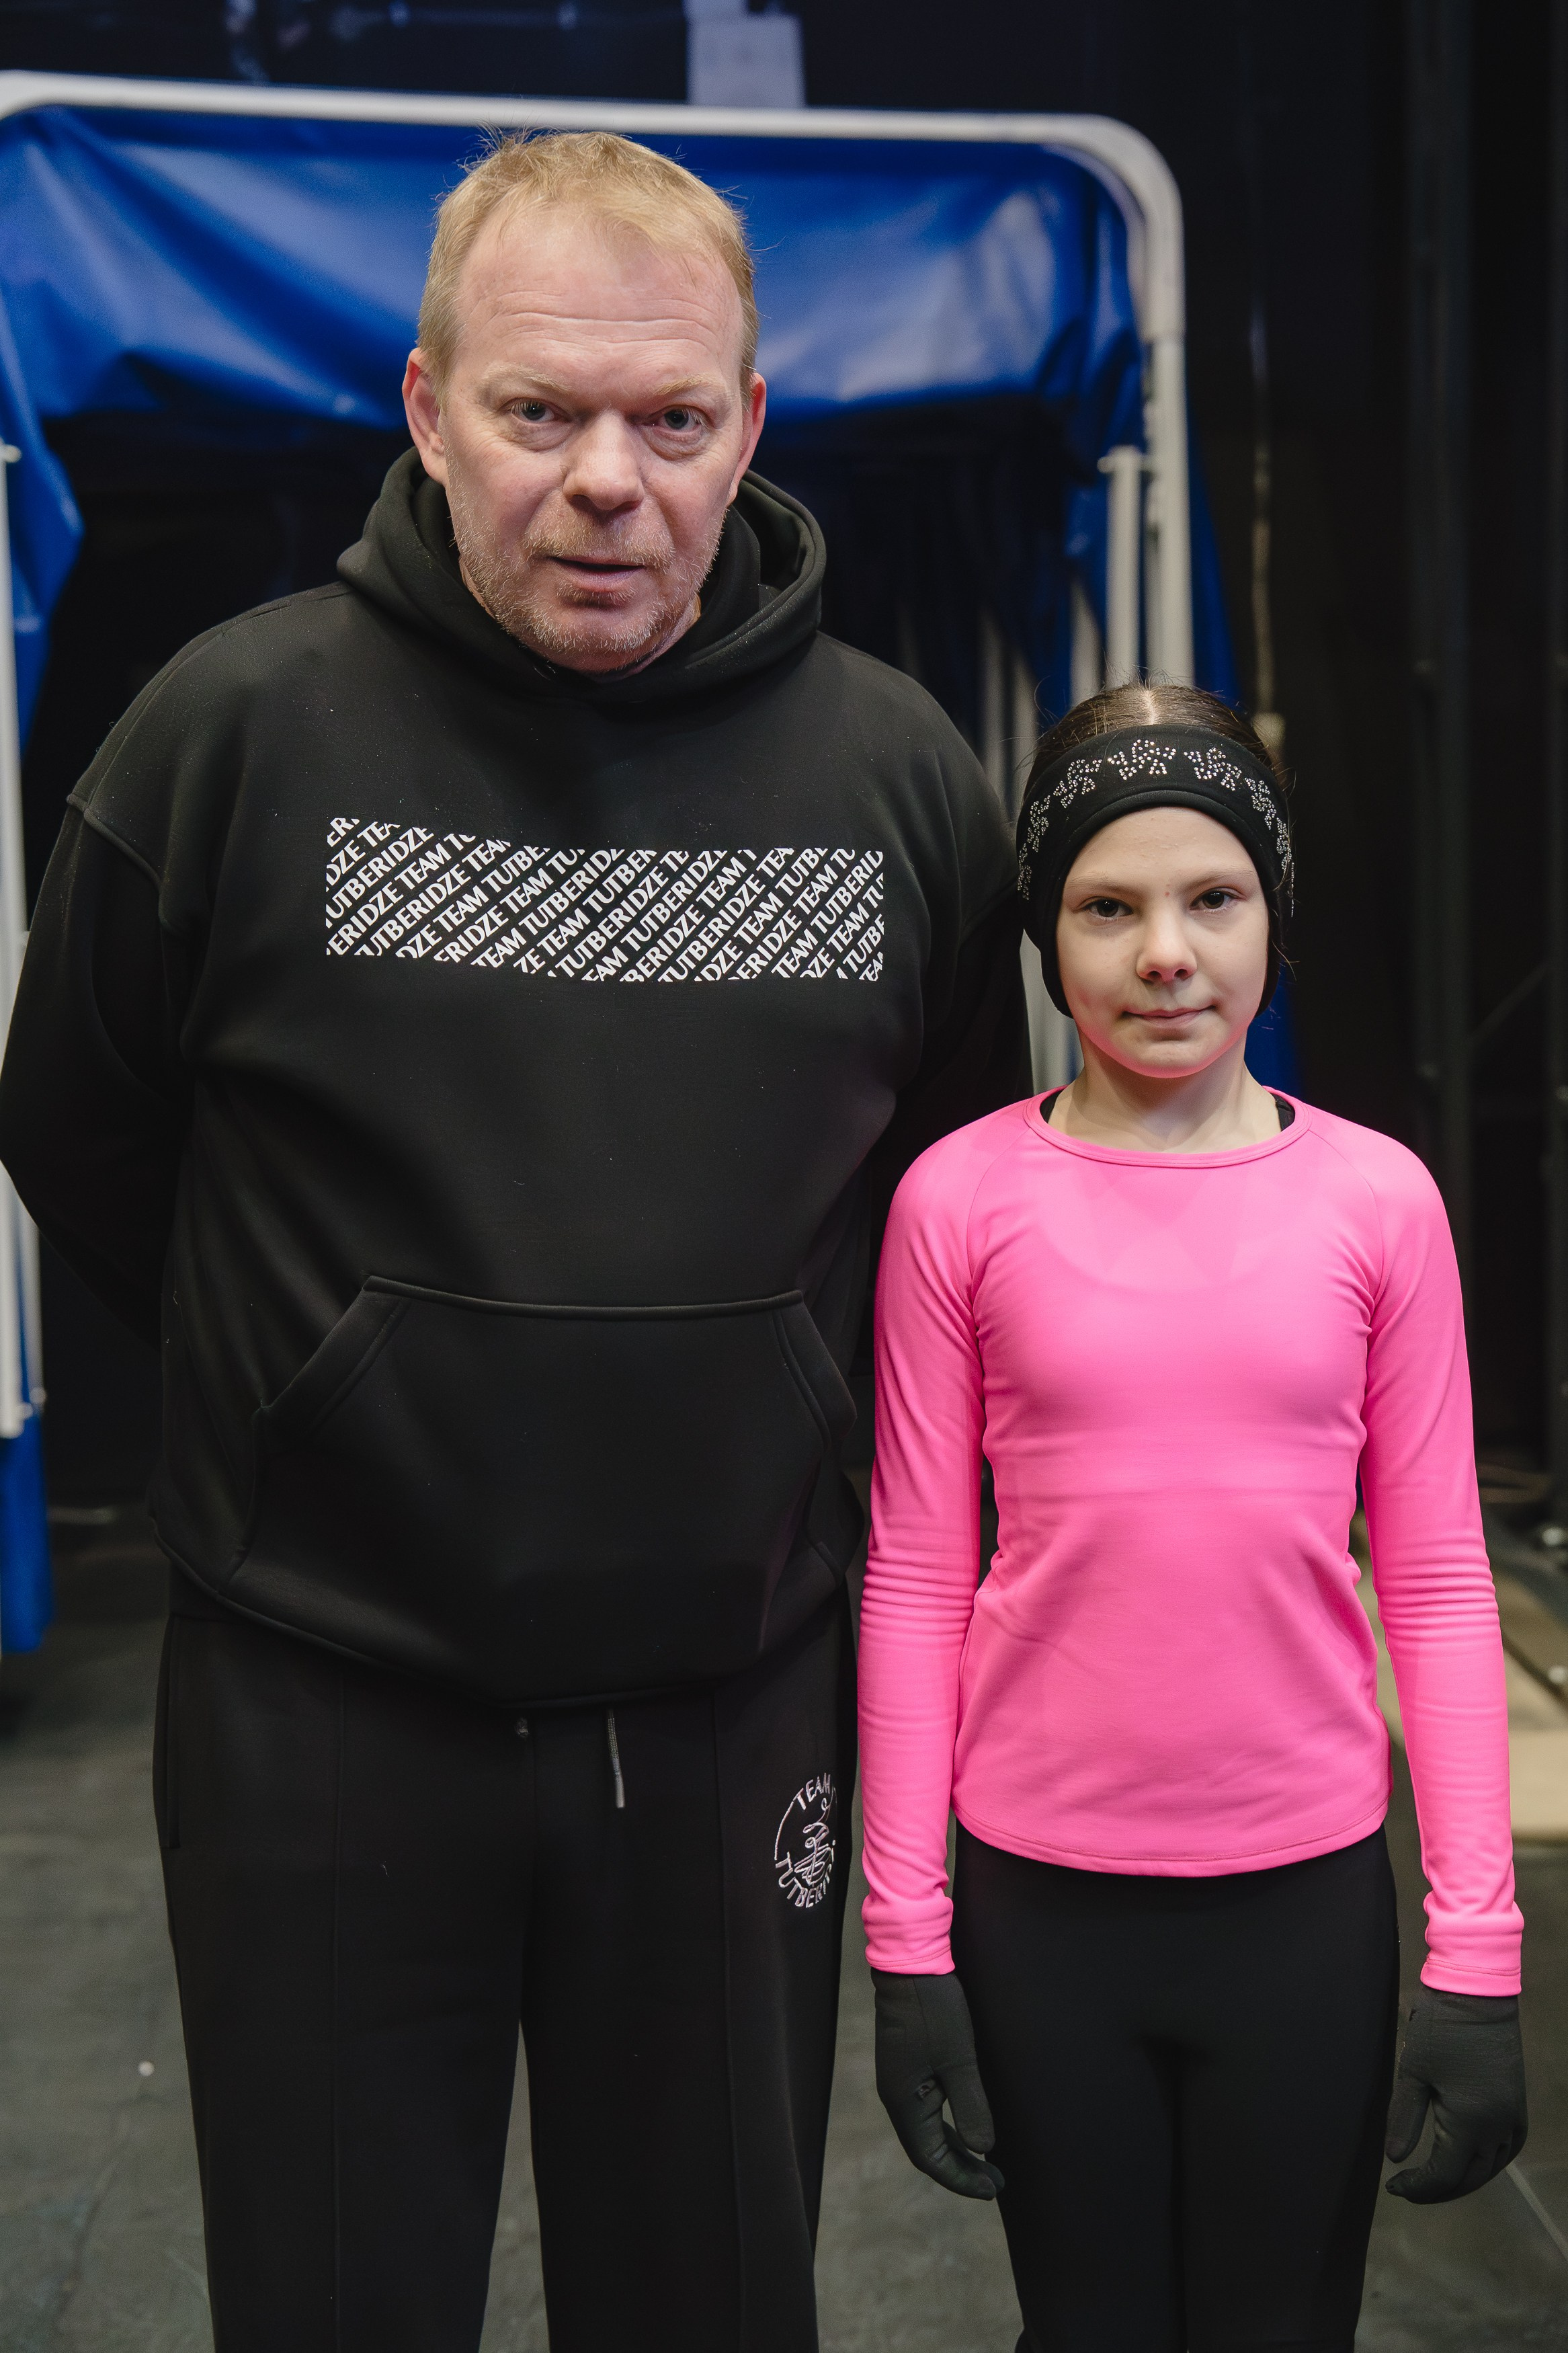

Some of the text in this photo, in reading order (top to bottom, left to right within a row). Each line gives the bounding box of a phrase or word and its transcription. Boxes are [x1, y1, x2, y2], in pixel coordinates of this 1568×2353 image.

[327, 817, 360, 847] ER
[325, 826, 435, 929] UTBERIDZE
[326, 840, 366, 892] DZE
[326, 881, 404, 955] ERIDZE
[394, 842, 452, 890] TEAM
[432, 885, 490, 933] TEAM
[480, 845, 550, 893] TUTBE
[499, 867, 554, 914] TEAM
[545, 848, 586, 875] TU
[536, 908, 591, 957] TEAM
[554, 865, 669, 978] TUTBERIDZE
[619, 856, 748, 982] BERIDZE TEAM
[657, 873, 766, 982] TUTBERIDZE
[727, 909, 802, 980] ERIDZE
[792, 863, 839, 915] TEAM
[733, 891, 784, 945] TEAM
[826, 902, 870, 953] TEAM
[770, 928, 819, 978] TEAM
[792, 1772, 831, 1810] TEAM
